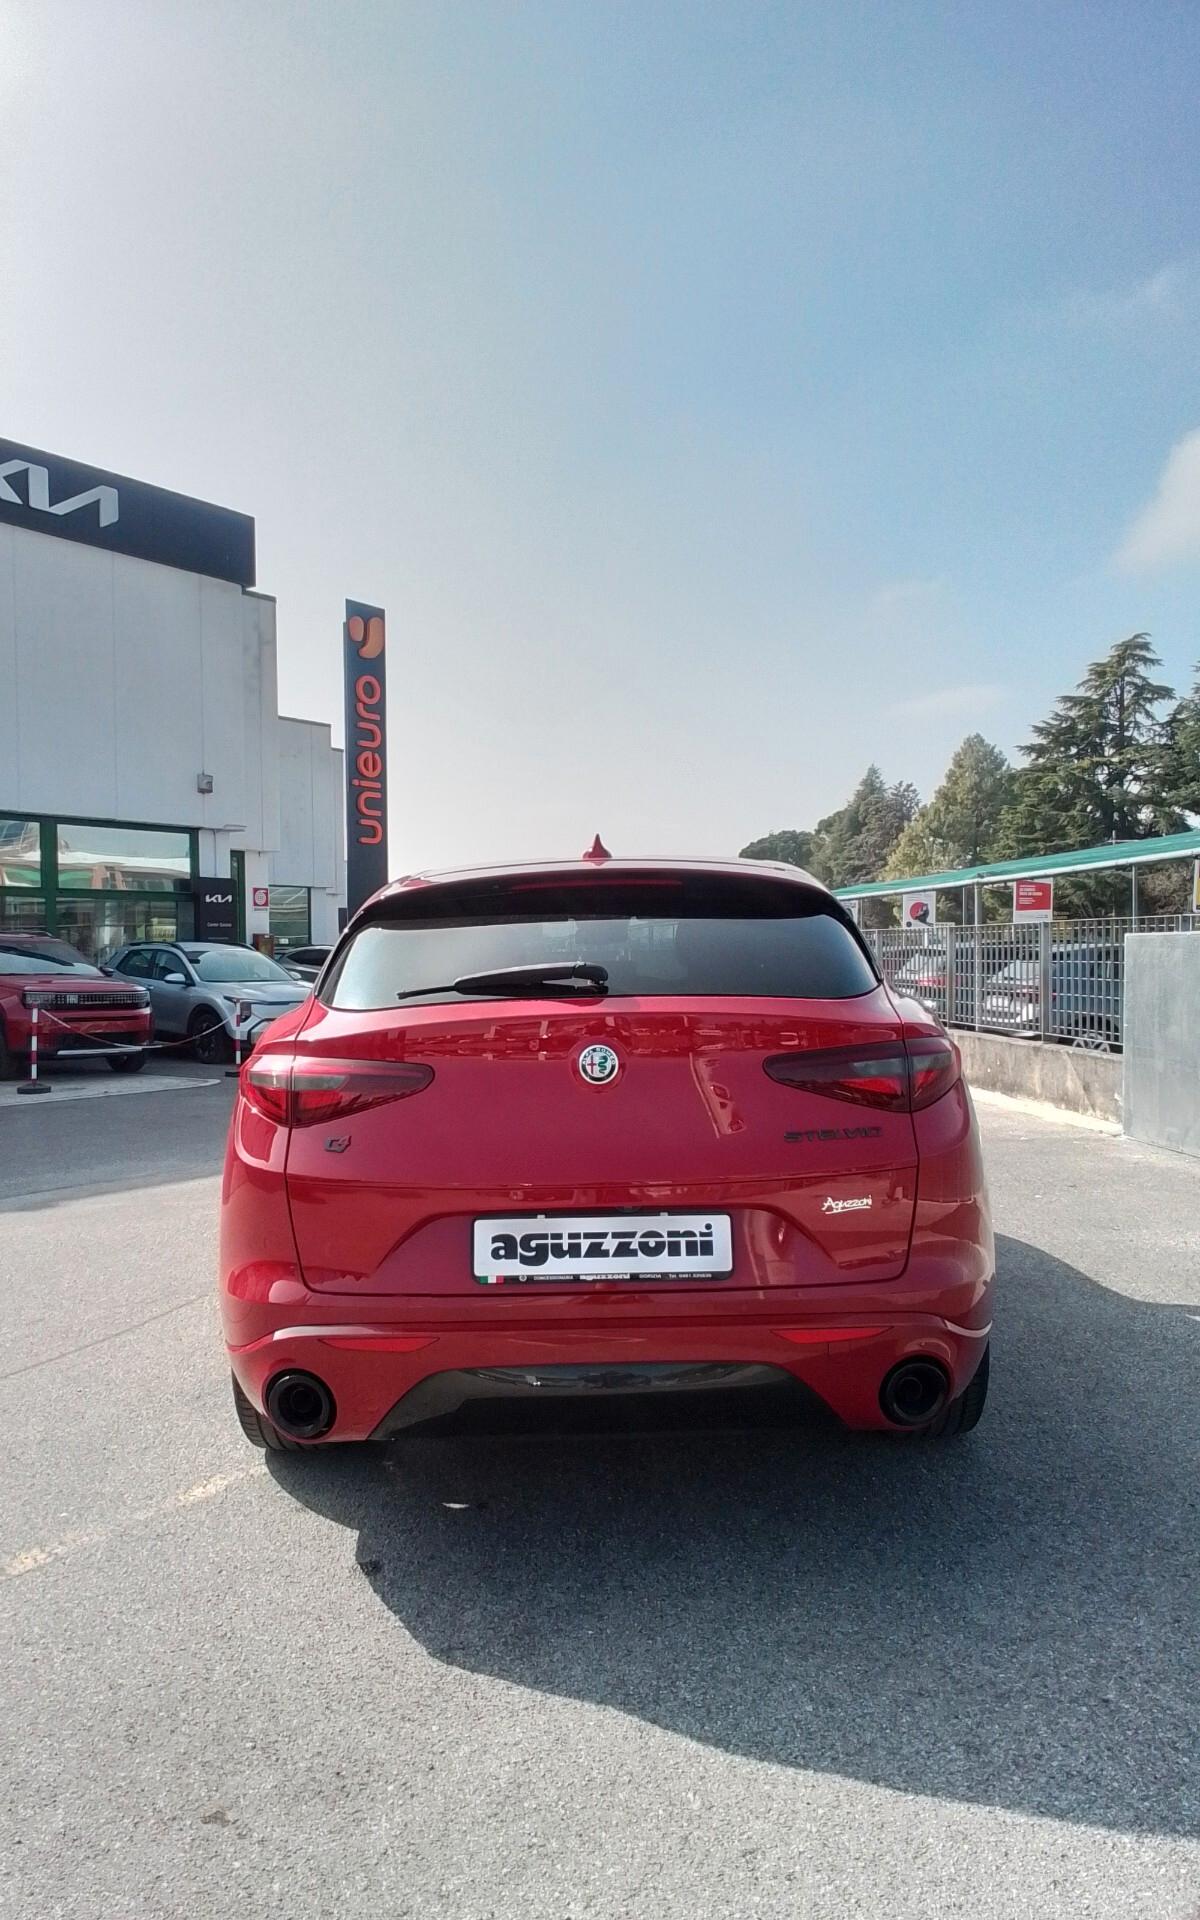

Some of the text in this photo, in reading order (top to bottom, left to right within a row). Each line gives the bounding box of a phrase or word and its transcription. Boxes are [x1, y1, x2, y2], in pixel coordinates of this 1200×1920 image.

[354, 674, 383, 846] unieuro
[205, 894, 233, 903] KIA
[784, 1126, 883, 1144] STELVIO
[490, 1223, 714, 1266] aguzzoni
